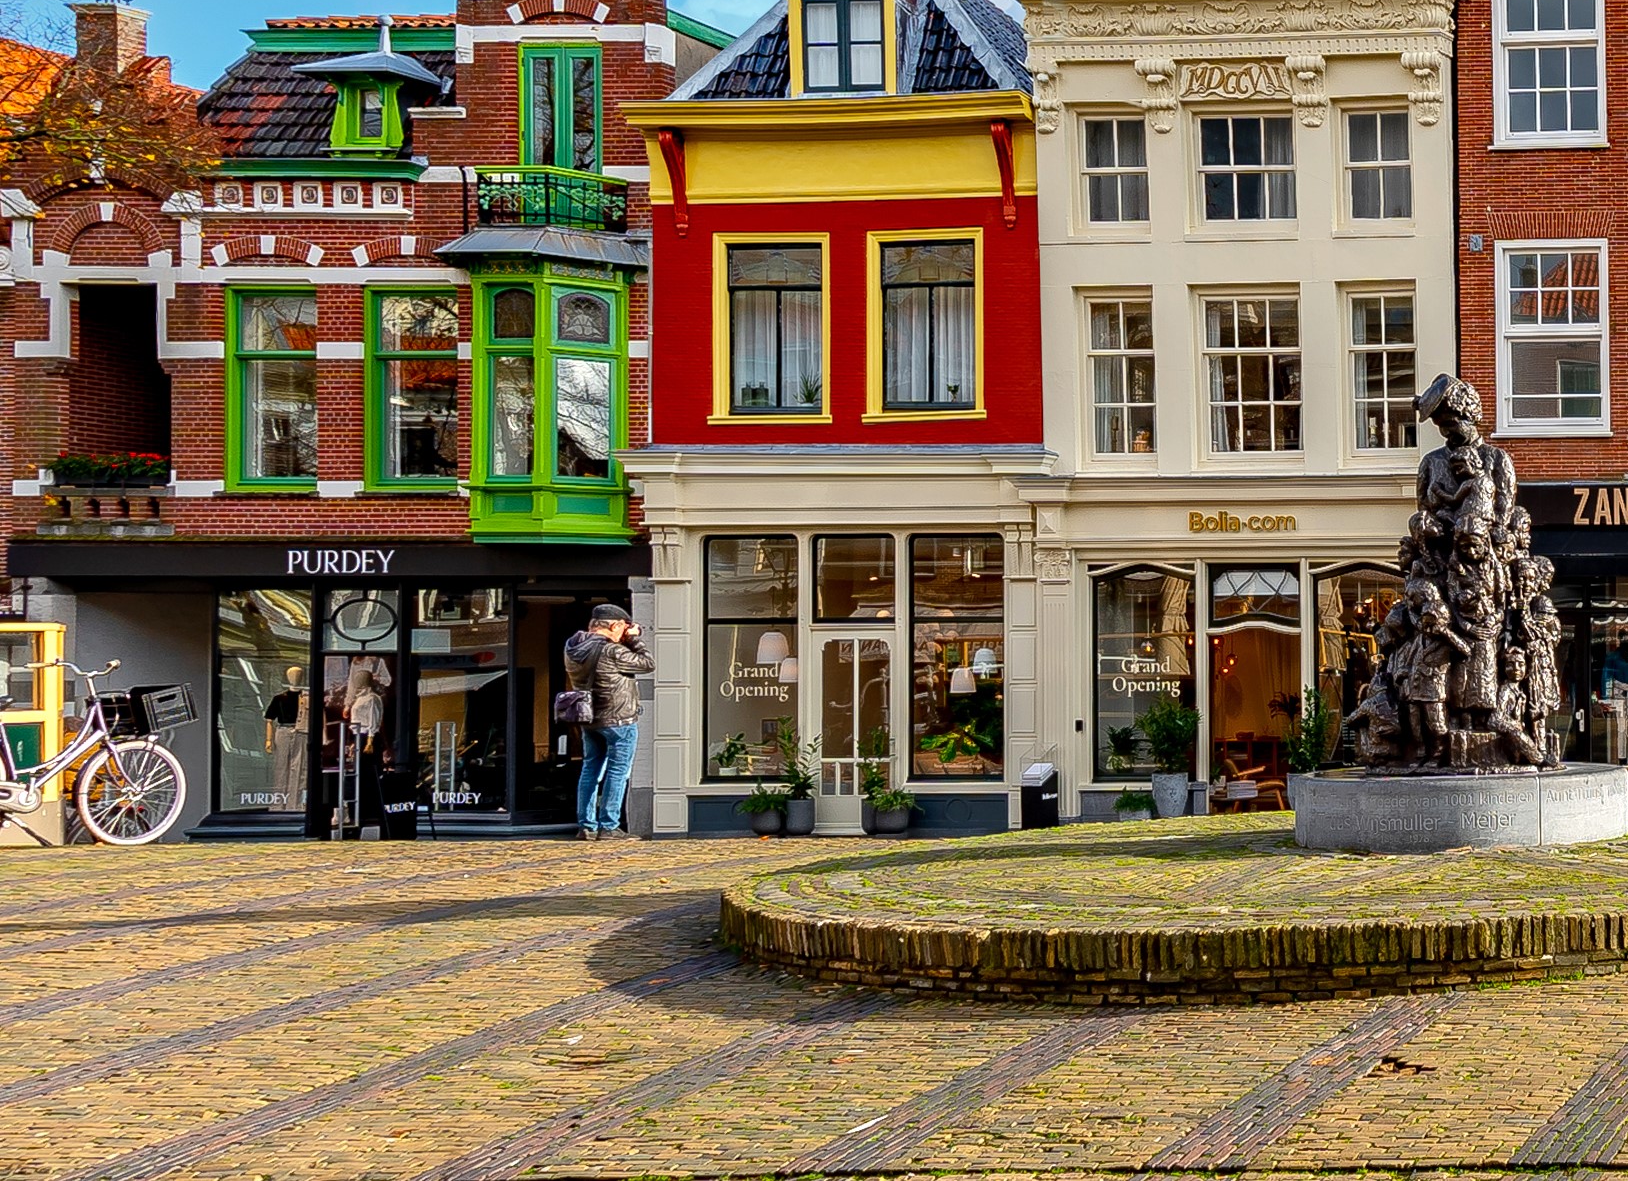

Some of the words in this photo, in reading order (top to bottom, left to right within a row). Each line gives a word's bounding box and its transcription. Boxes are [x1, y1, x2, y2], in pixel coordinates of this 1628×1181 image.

[286, 549, 396, 574] PURDEY
[729, 660, 779, 678] Grand
[1121, 655, 1171, 673] Grand
[720, 679, 789, 702] Opening
[1112, 675, 1181, 697] Opening
[240, 792, 290, 805] PURDEY
[432, 792, 482, 805] PURDEY
[1445, 792, 1475, 807] 1001
[1461, 810, 1516, 832] Meijer
